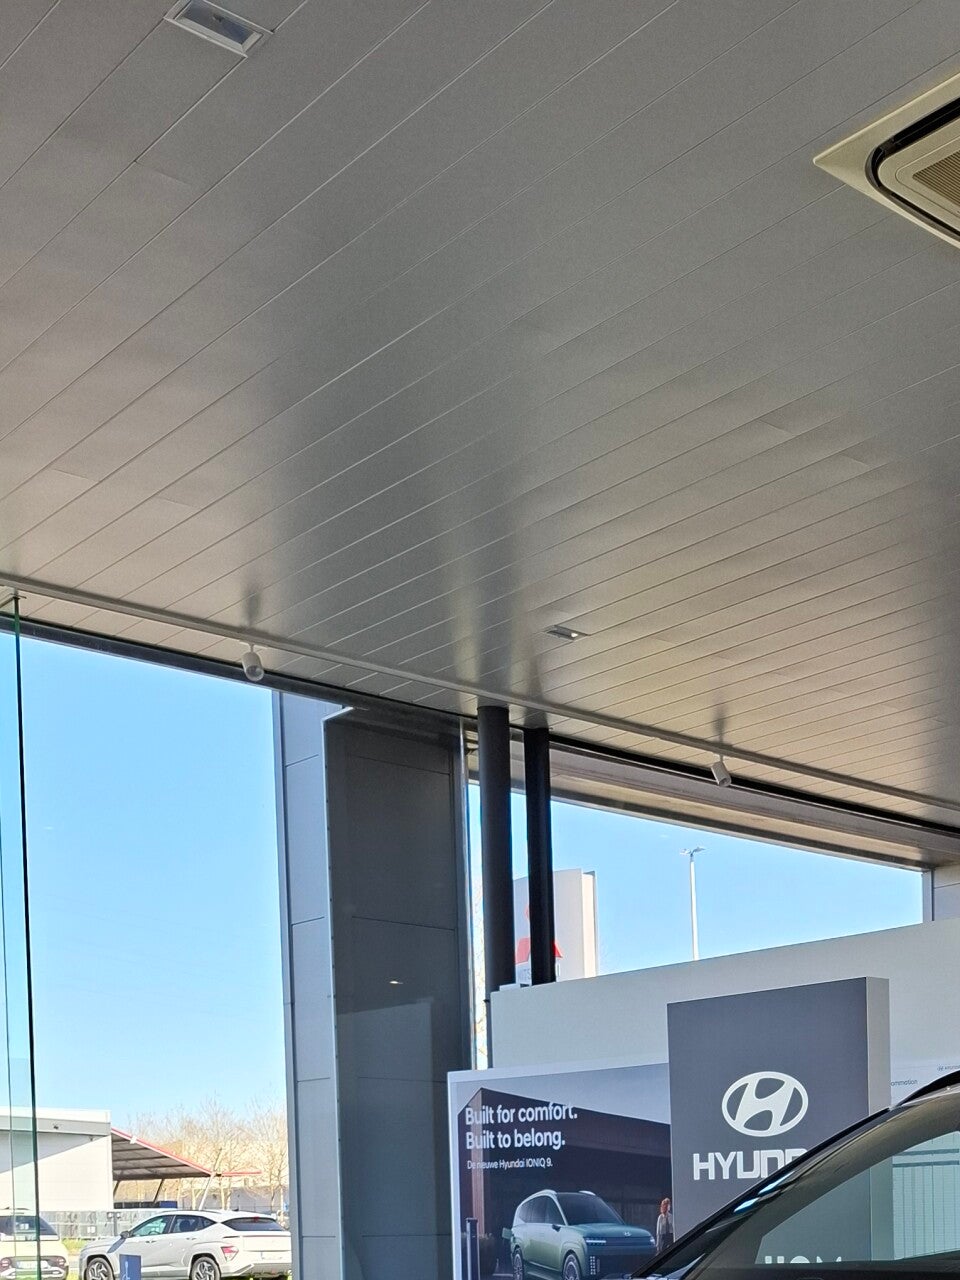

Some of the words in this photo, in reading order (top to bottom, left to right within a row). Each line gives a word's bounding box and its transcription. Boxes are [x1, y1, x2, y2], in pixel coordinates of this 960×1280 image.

[465, 1105, 495, 1125] Built
[497, 1104, 516, 1123] for
[518, 1101, 578, 1122] comfort.
[466, 1130, 495, 1149] Built
[497, 1131, 511, 1148] to
[514, 1128, 566, 1150] belong.
[467, 1160, 476, 1169] De
[477, 1160, 498, 1169] nieuwe
[499, 1158, 525, 1170] Hyundai
[526, 1157, 545, 1168] IONIQ
